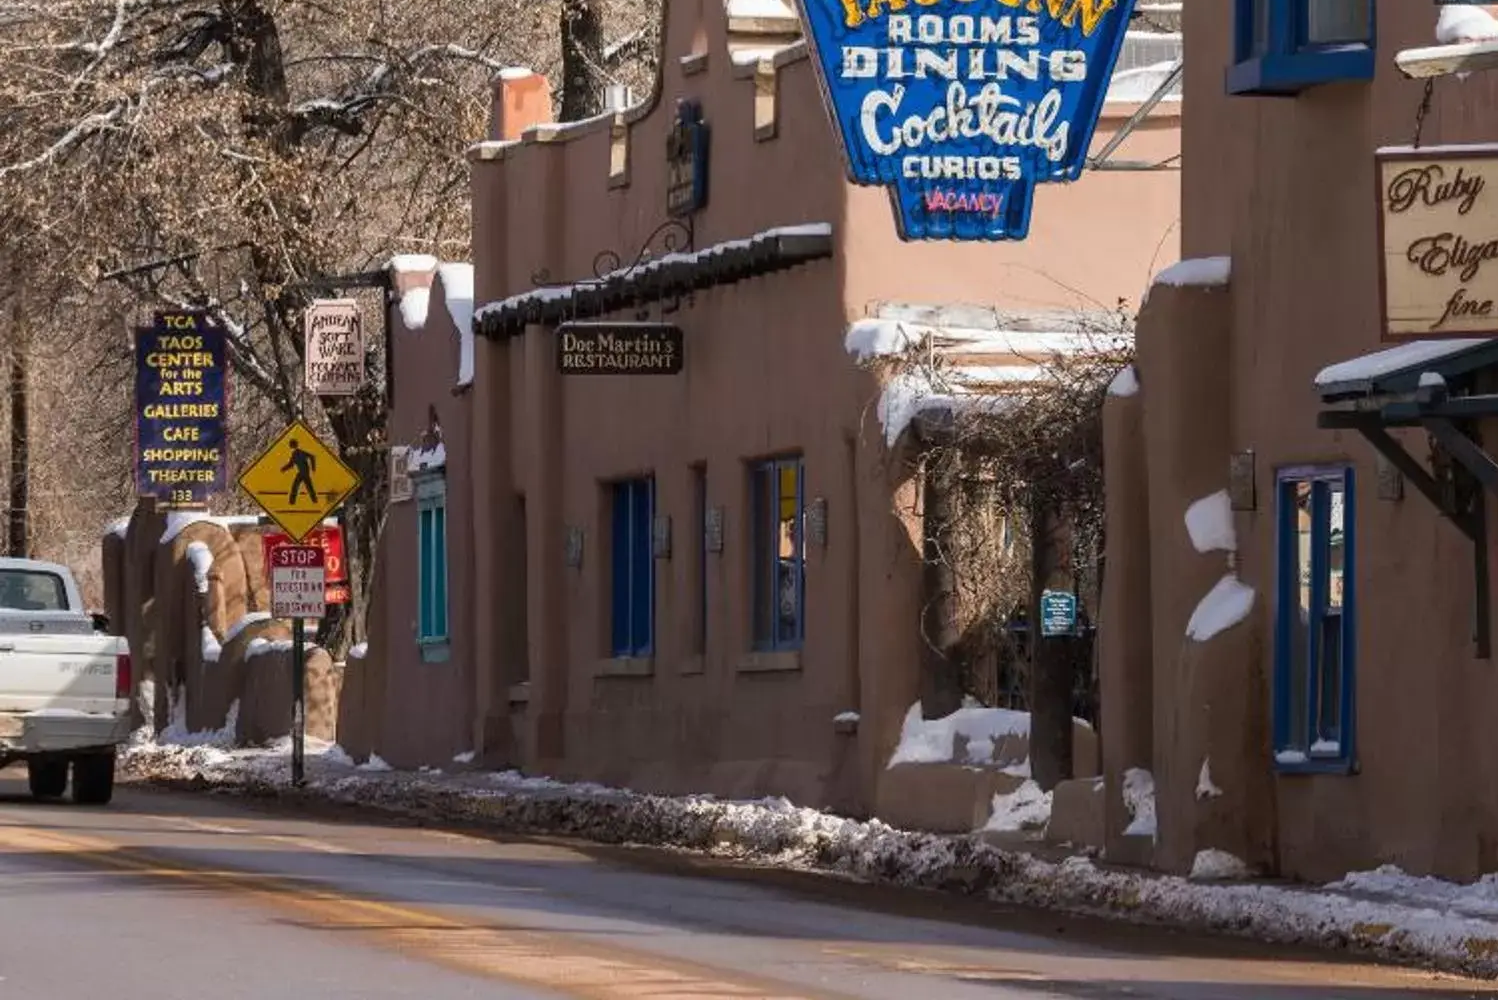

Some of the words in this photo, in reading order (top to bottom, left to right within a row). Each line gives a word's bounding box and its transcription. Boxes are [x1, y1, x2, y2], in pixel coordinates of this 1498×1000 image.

[888, 14, 1040, 45] ROOMS
[841, 46, 1088, 82] DINING
[860, 81, 1071, 162] Cocktails
[902, 155, 1022, 180] CURIOS
[1387, 164, 1485, 216] Ruby
[925, 186, 1005, 218] VACANCY
[1429, 288, 1494, 330] fine
[163, 315, 196, 329] TCA
[158, 335, 204, 350] TAOS
[563, 333, 595, 352] Doc
[598, 332, 675, 353] Martin's
[145, 351, 215, 367] CENTER
[563, 354, 675, 369] RESTAURANT
[160, 367, 179, 379] for
[182, 367, 203, 379] the
[159, 381, 204, 396] ARTS
[143, 403, 219, 418] GALLERIES
[162, 426, 199, 442] CAFE
[142, 448, 220, 462] SHOPPING
[147, 469, 215, 483] THEATER
[171, 489, 193, 501] 133
[280, 549, 318, 565] STOP
